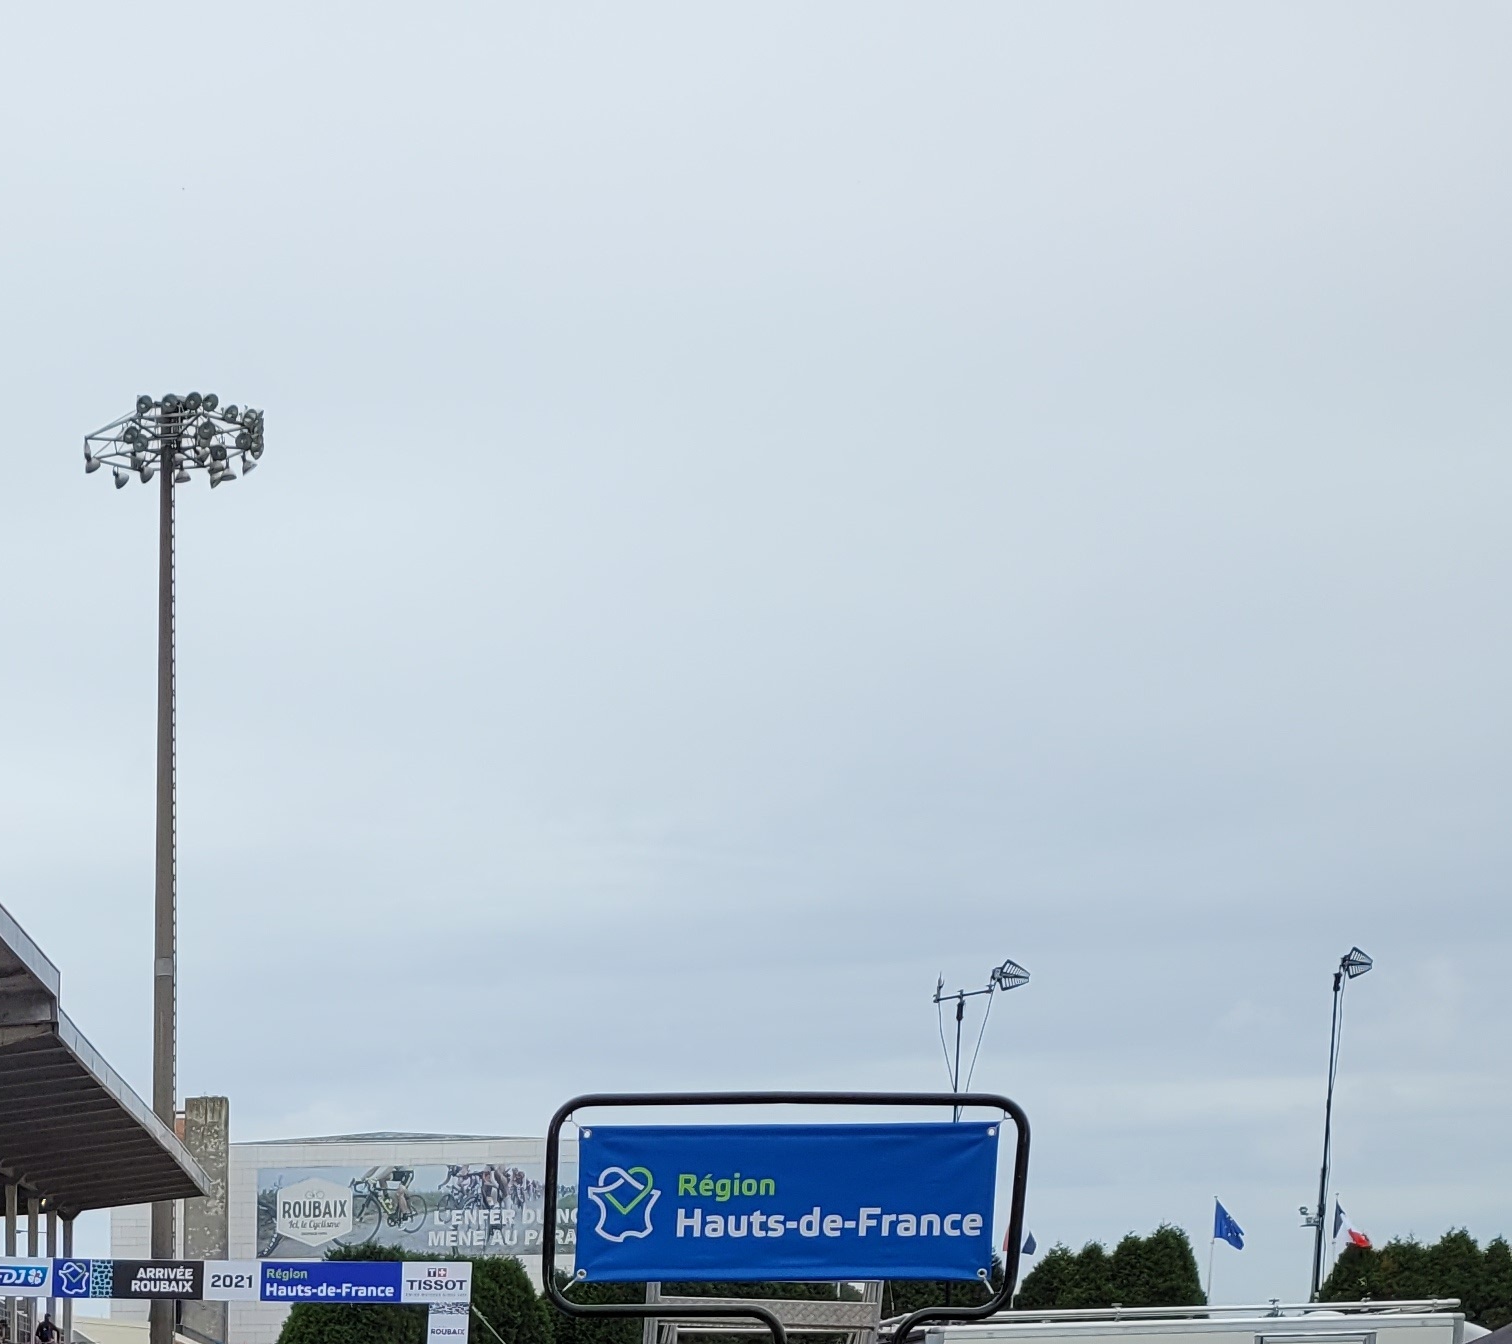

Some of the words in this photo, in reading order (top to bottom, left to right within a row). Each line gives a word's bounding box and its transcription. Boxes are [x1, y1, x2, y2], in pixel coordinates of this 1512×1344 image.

[678, 1172, 776, 1202] Région
[283, 1200, 348, 1220] ROUBAIX
[433, 1209, 515, 1226] L'ENFER
[676, 1206, 983, 1238] Hauts-de-France
[488, 1229, 517, 1245] AU
[137, 1266, 194, 1280] ARRIVÉE
[210, 1273, 254, 1289] 2021
[266, 1268, 308, 1282] Région
[131, 1279, 193, 1293] ROUBAIX
[265, 1282, 395, 1298] Hauts-de-France
[405, 1279, 468, 1291] TISSOT
[431, 1328, 465, 1336] ROUBAIX
